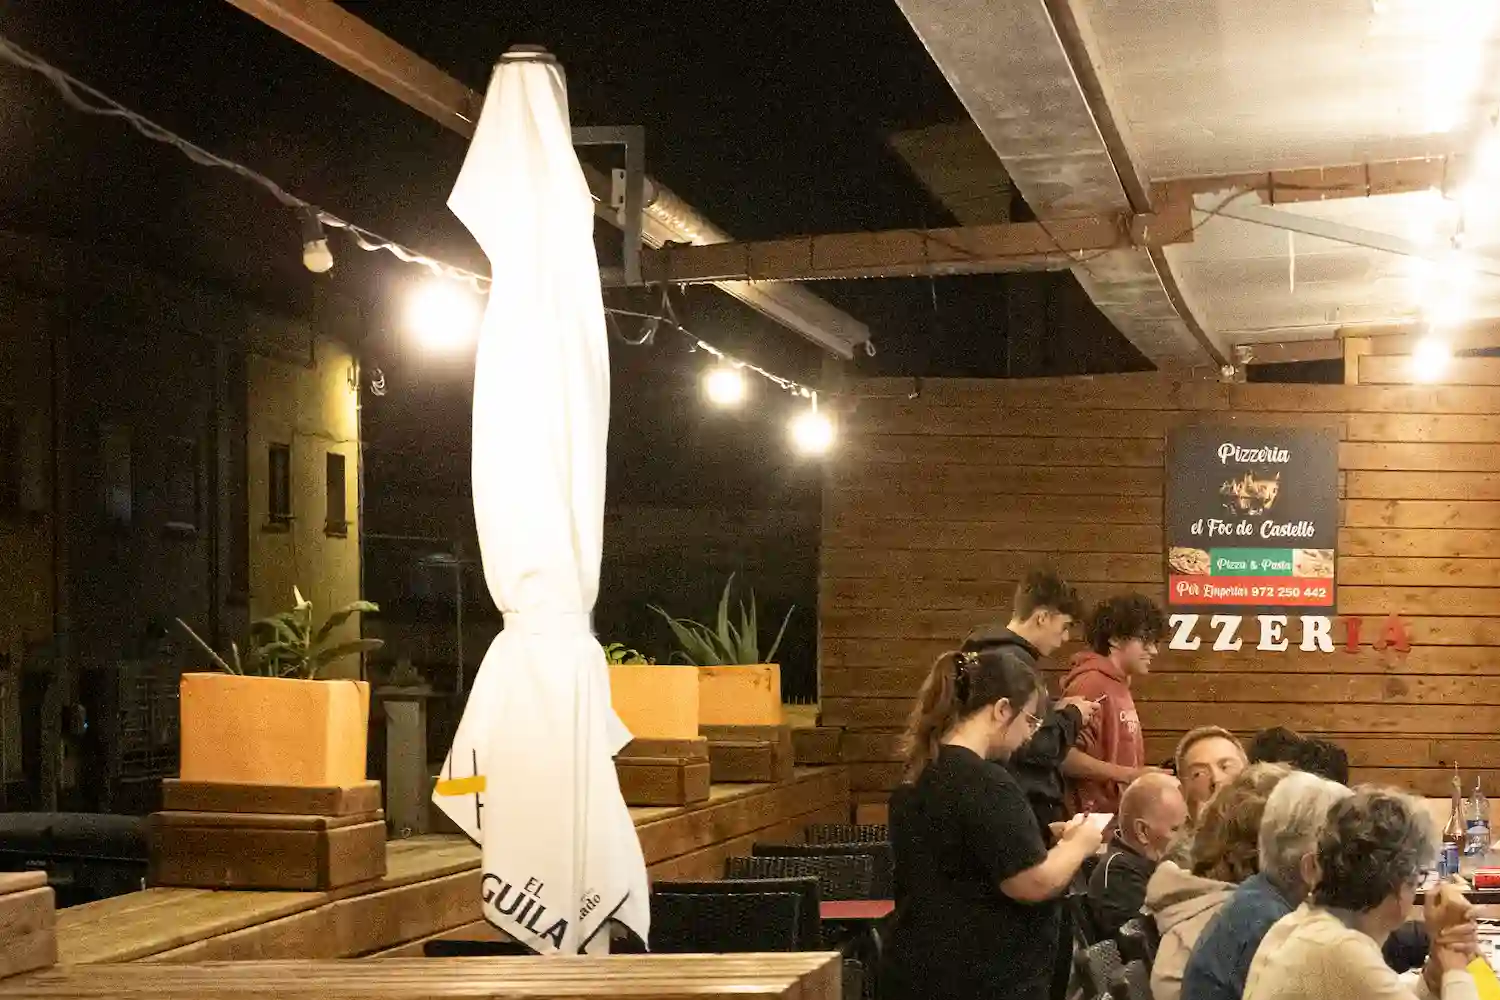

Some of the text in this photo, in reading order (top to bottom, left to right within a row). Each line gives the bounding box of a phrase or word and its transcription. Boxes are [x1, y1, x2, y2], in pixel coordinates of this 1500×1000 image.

[1217, 442, 1290, 465] Pizzeria
[1190, 518, 1204, 535] el
[1207, 518, 1233, 537] Foc
[1235, 519, 1254, 536] de
[1216, 557, 1292, 571] Pizza & Pasta
[1251, 586, 1275, 598] 972
[1277, 587, 1301, 598] 250
[1303, 587, 1327, 598] 442
[1168, 612, 1411, 654] ZZERIA
[524, 876, 545, 899] EL
[482, 872, 569, 950] GUILA
